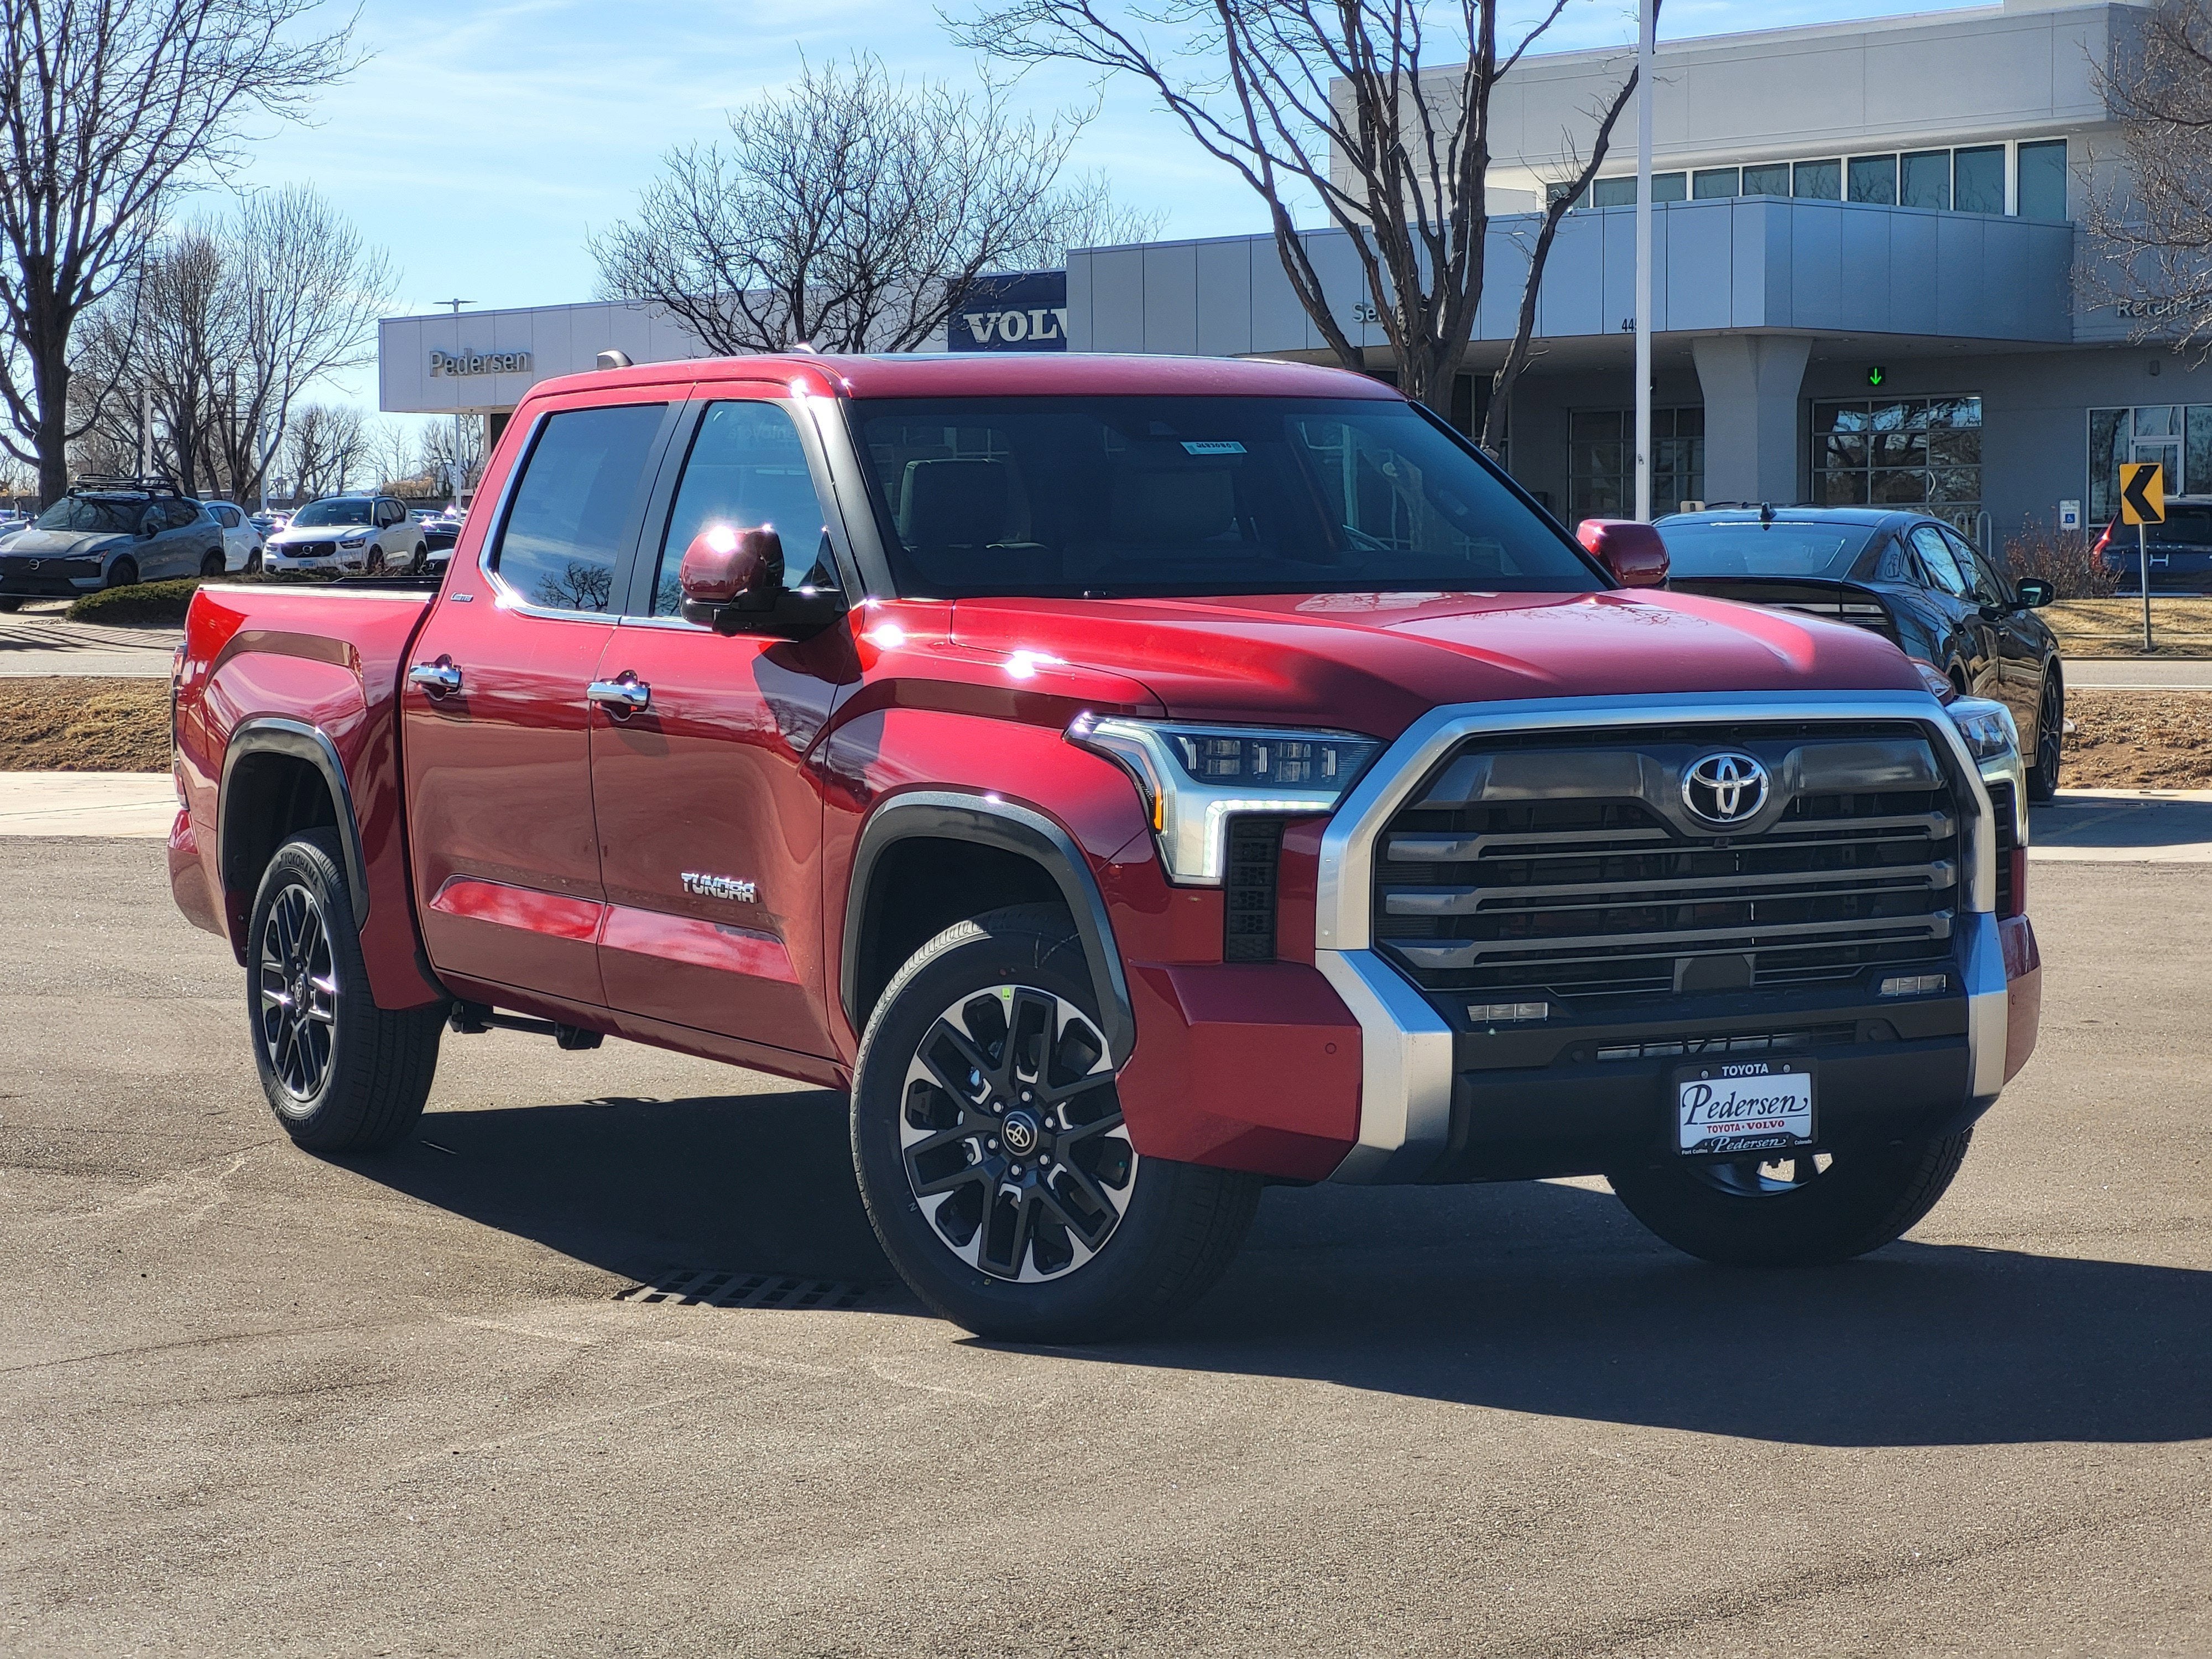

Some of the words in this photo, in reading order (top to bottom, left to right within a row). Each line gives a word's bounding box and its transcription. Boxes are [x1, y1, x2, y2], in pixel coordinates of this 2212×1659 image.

[1621, 317, 1637, 332] 44
[429, 348, 532, 377] Pedersen
[284, 852, 319, 890] YOKOHAMA
[681, 872, 757, 904] TUNDRA
[1721, 1063, 1769, 1077] TOYOTA
[1682, 1083, 1808, 1126] Pedersen
[1707, 1123, 1741, 1134] TOYOTA
[1746, 1120, 1785, 1130] VOLVO
[1710, 1136, 1787, 1154] Pedersen
